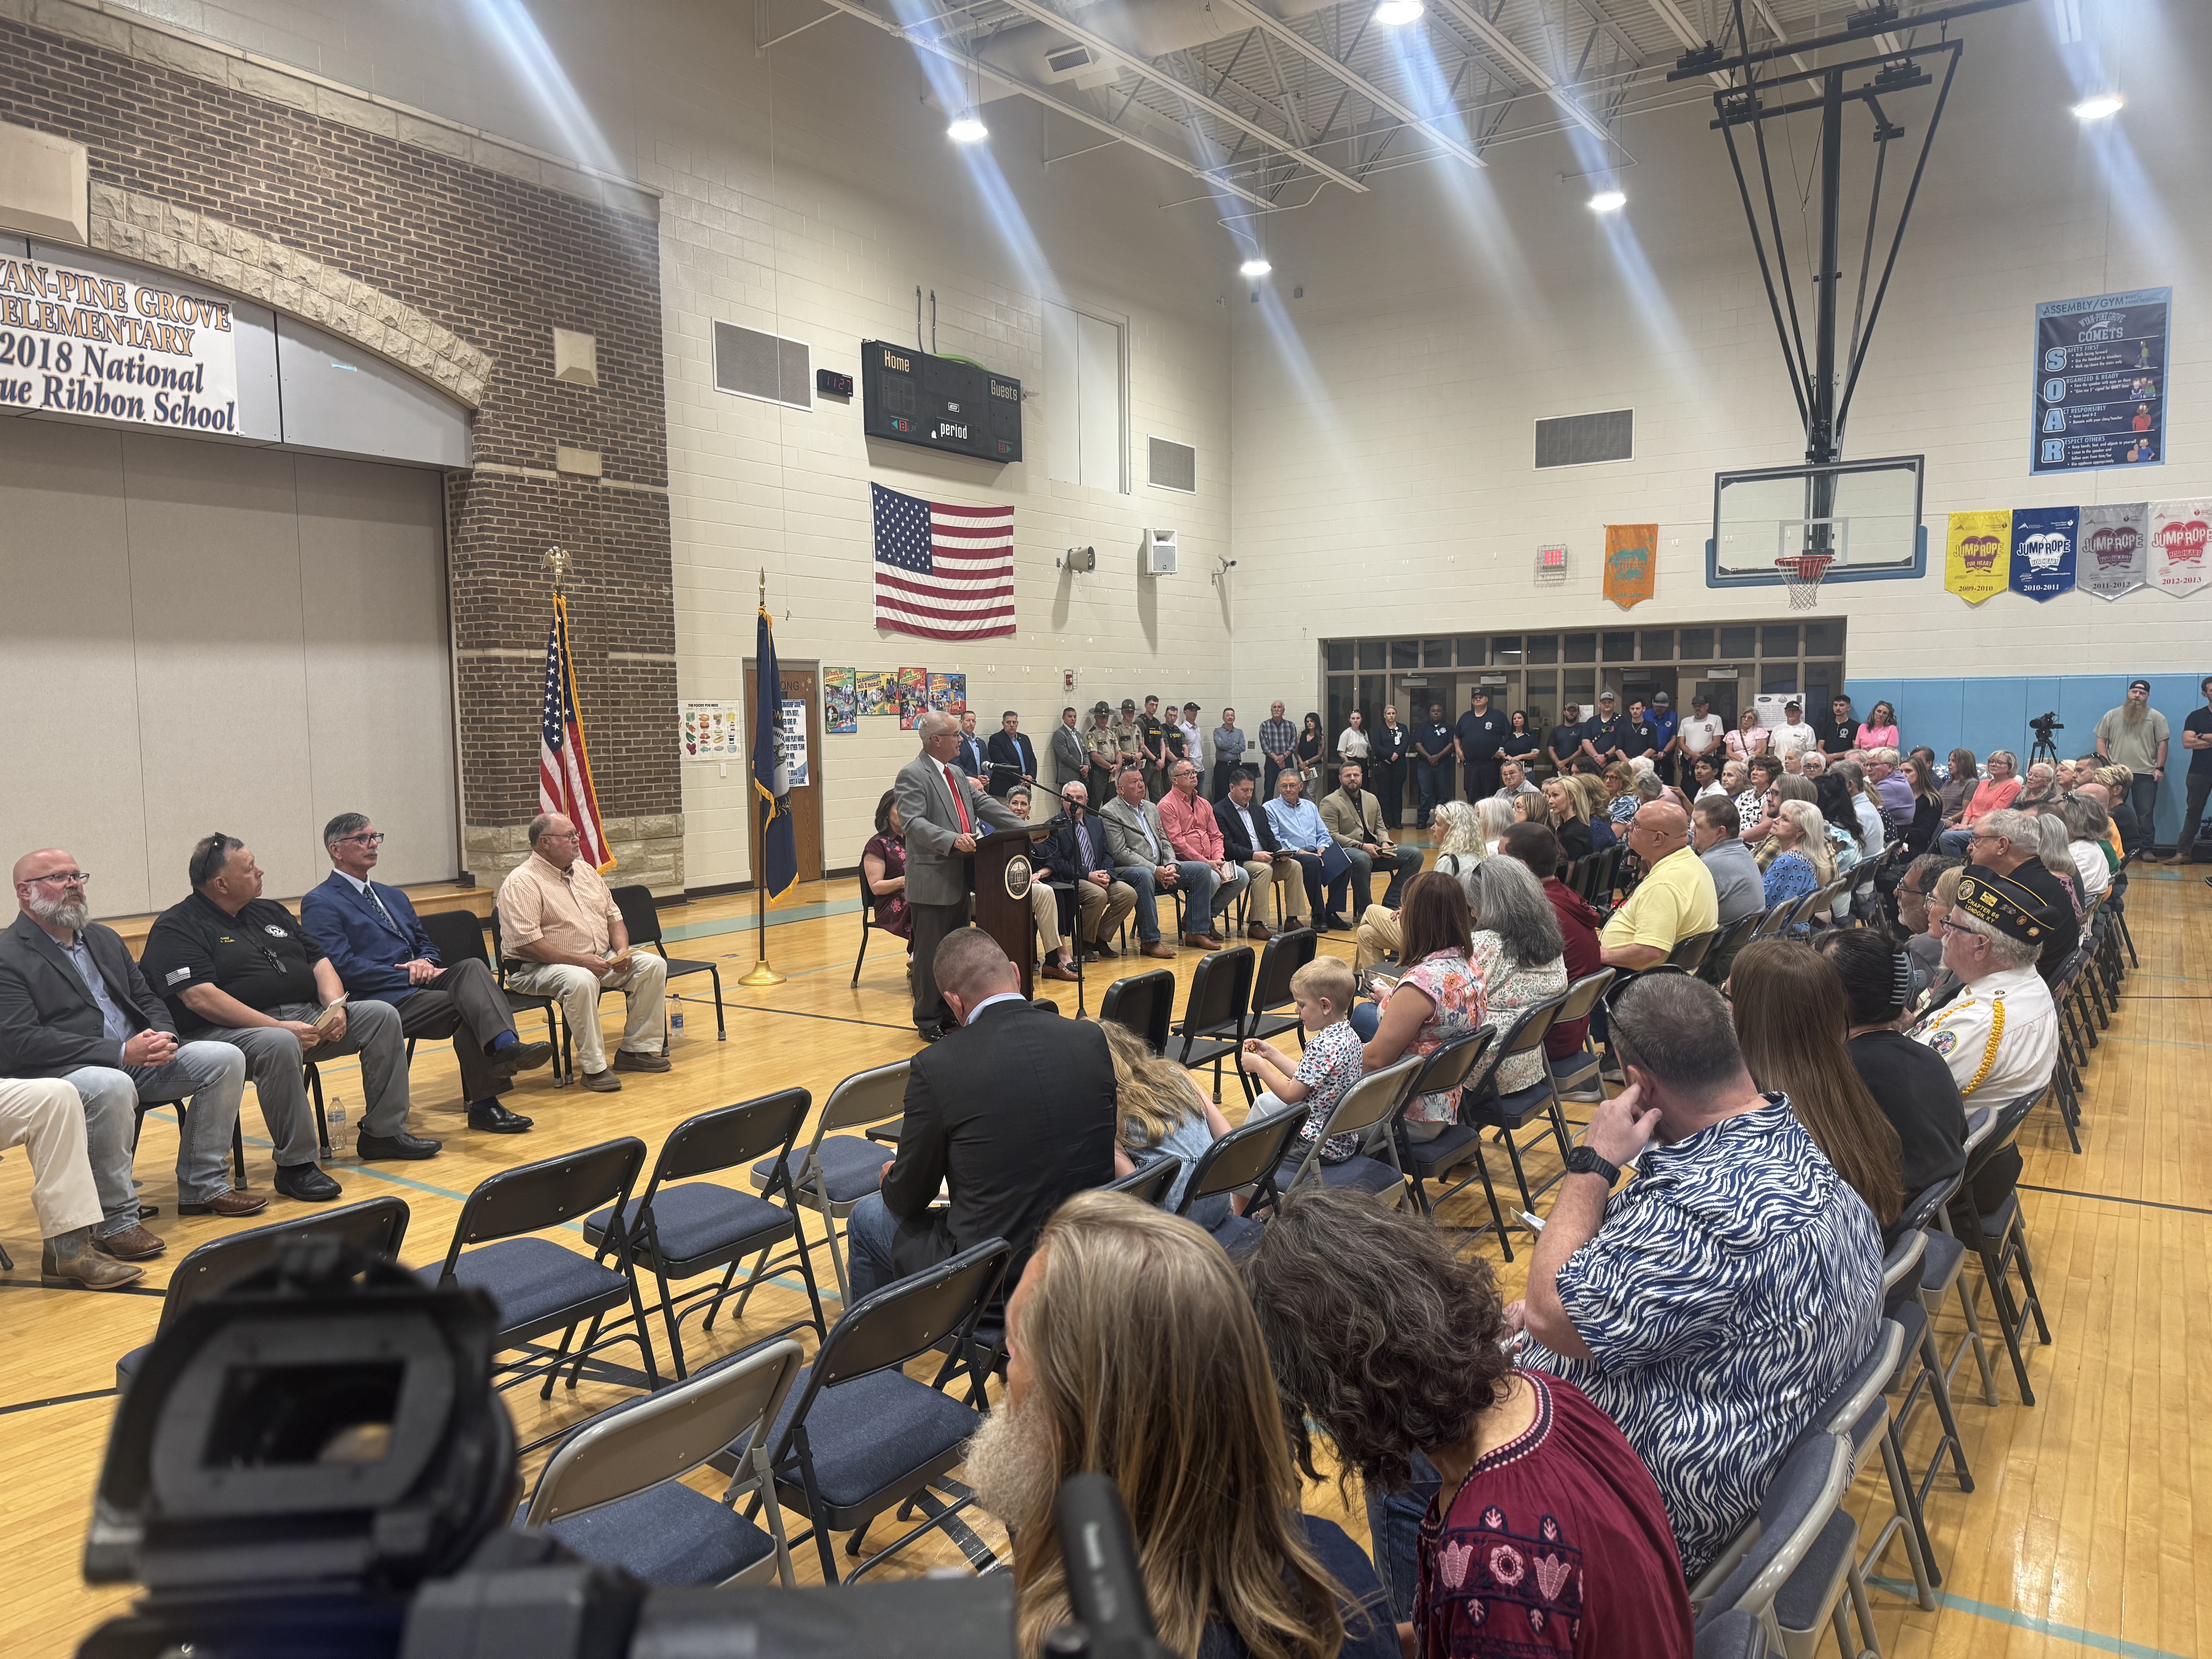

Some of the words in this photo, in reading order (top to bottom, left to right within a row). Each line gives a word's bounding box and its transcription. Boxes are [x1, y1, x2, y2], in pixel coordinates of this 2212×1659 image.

[135, 287, 231, 332] GROVE
[2043, 297, 2124, 315] ASSEMBLY/GYM
[0, 293, 194, 357] ELEMENTARY
[2108, 312, 2126, 323] GROVE
[2078, 327, 2123, 343] COMETS
[0, 330, 73, 374] 2018
[81, 343, 203, 394] National
[884, 350, 910, 373] Home
[2045, 347, 2067, 372] S
[827, 375, 851, 391] 11:27
[991, 380, 1017, 401] Guests
[41, 373, 145, 421] Ribbon
[153, 391, 234, 431] School
[2071, 405, 2106, 414] RESPONSIBLY
[940, 422, 967, 440] period
[2082, 536, 2114, 553] JUMP
[2114, 534, 2143, 551] ROPE
[2152, 531, 2184, 548] JUMP
[2185, 527, 2212, 546] ROPE
[1953, 543, 1979, 557] JUMP
[1980, 542, 2004, 556] ROPE
[2017, 542, 2045, 556] JUMP
[2045, 539, 2070, 555] ROPE
[1965, 904, 1985, 920] LONDON,
[1967, 898, 1991, 915] CHAPTER
